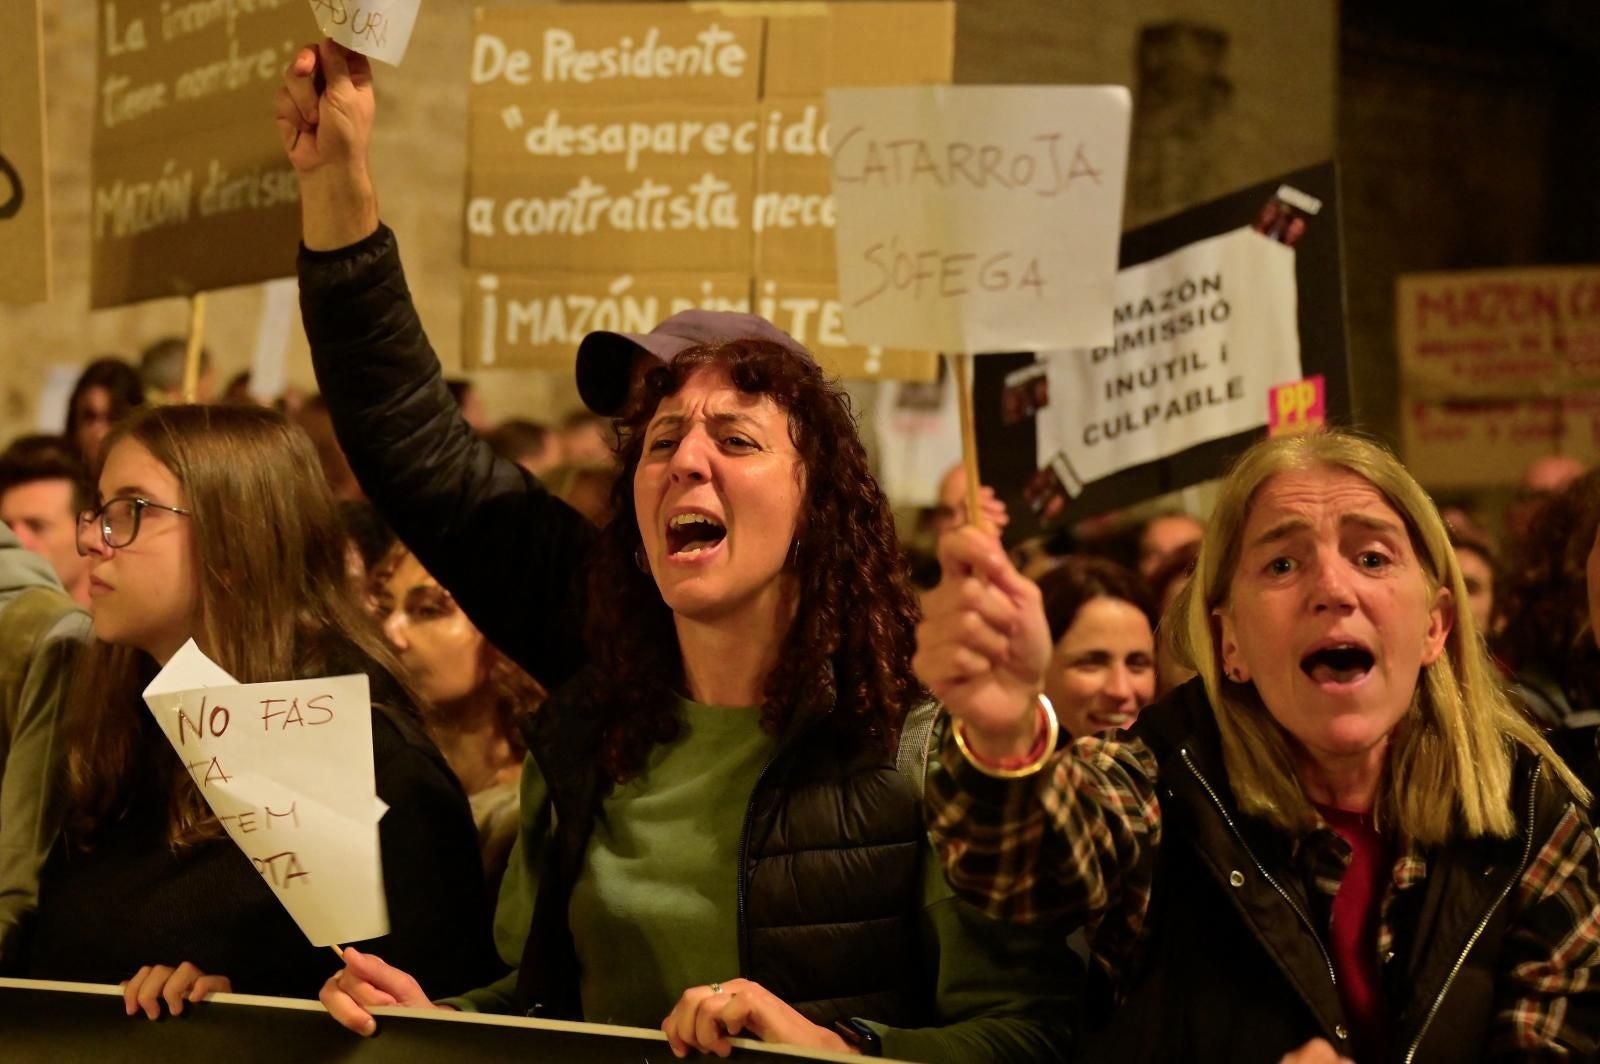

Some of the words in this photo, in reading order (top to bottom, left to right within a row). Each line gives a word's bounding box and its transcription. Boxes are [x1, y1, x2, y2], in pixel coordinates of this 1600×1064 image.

[471, 34, 532, 85] De
[541, 22, 748, 82] Presidente
[831, 125, 1104, 197] CATARROJA
[466, 196, 496, 237] a
[502, 171, 740, 236] contratista
[1081, 374, 1247, 447] CULPABLE
[177, 696, 230, 746] NO
[259, 694, 335, 731] FAS
